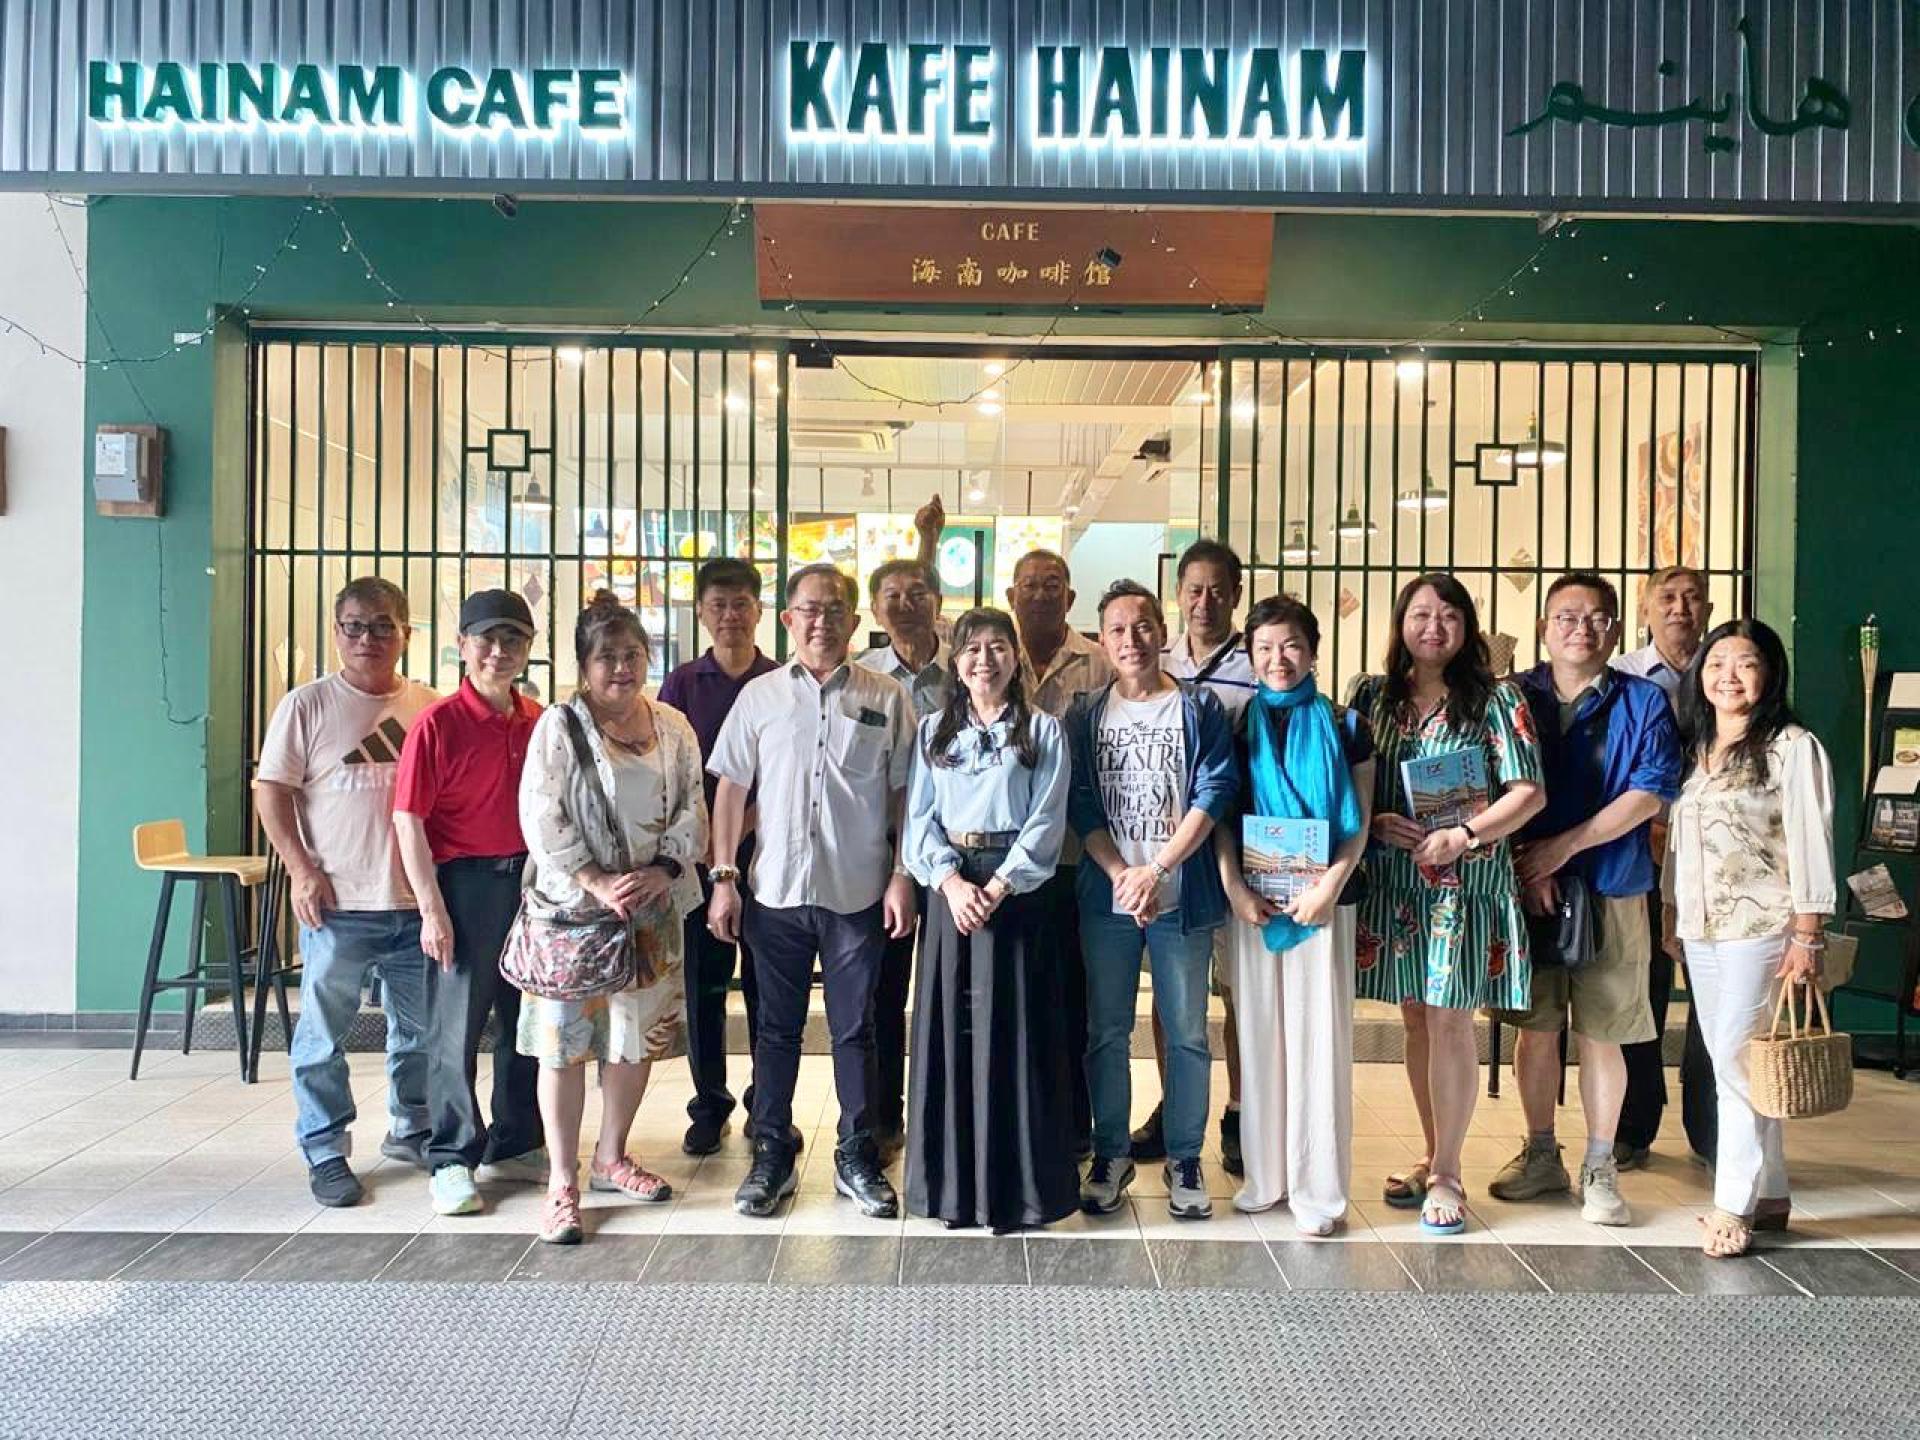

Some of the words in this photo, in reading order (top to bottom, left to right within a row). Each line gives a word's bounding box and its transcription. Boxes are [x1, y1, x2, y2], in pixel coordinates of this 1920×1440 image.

[88, 61, 403, 126] HAINAM
[425, 66, 627, 129] CAFE
[789, 40, 991, 135] KAFE
[1035, 46, 1367, 139] HAINAM
[980, 221, 1040, 241] CAFE
[911, 255, 1112, 287] 海南咖啡馆
